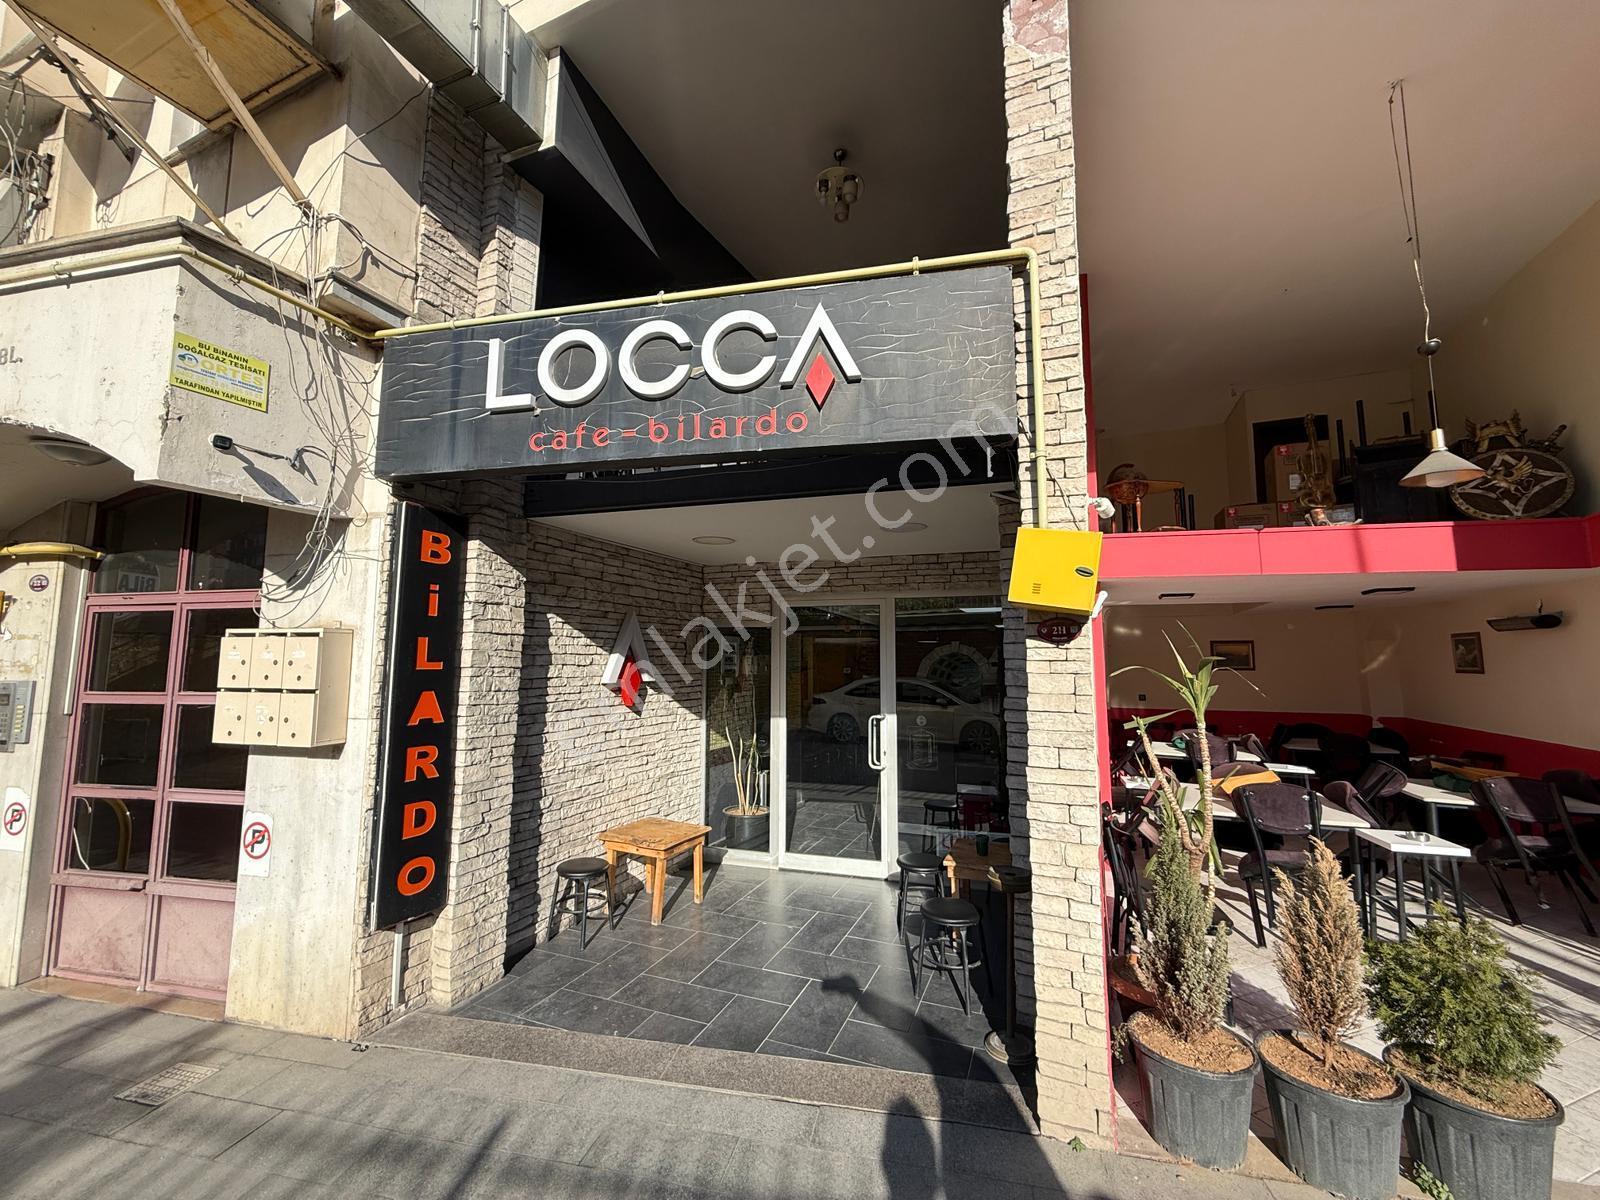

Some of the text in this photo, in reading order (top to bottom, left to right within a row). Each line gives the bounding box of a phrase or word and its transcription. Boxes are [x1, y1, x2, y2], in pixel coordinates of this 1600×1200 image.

[177, 342, 226, 364] DOĞALGAZ
[198, 342, 211, 351] BU
[485, 303, 862, 413] LOCCA
[174, 377, 220, 395] TARAFINDAN
